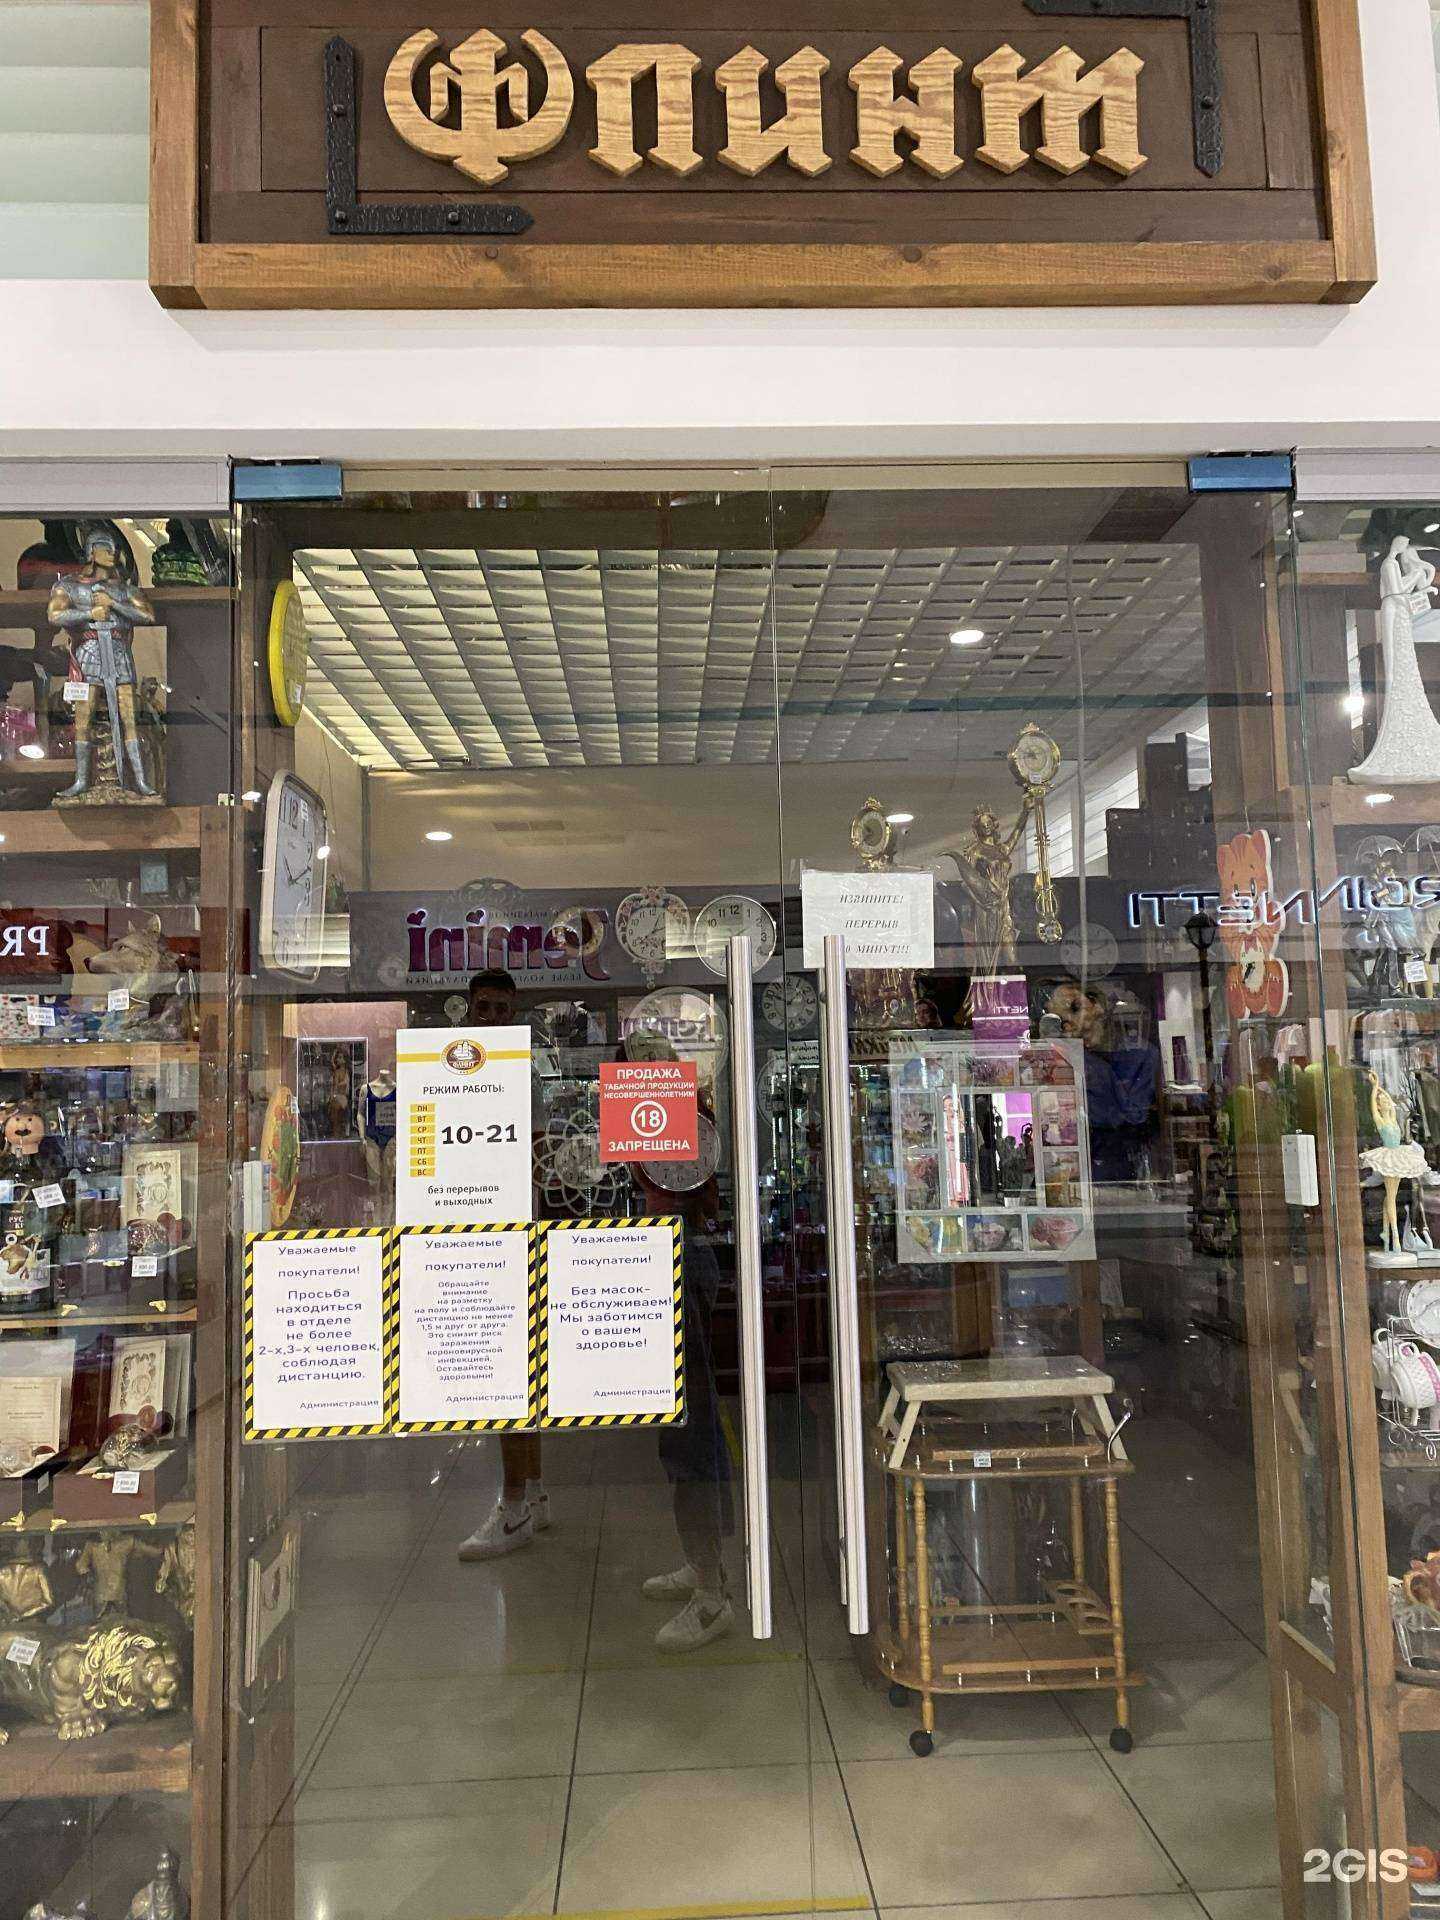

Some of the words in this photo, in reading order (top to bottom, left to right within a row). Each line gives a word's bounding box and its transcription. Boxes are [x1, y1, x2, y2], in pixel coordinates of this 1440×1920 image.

[840, 894, 904, 904] ИЗВИНИТЕ!
[728, 904, 740, 915] 12
[845, 920, 899, 929] ПЕРЕРЫВ
[856, 944, 910, 954] МИНУТ!!!
[616, 1068, 682, 1080] ПРОДАЖА
[423, 1086, 460, 1095] РЕЖИМ
[462, 1084, 505, 1094] РАБОТЫ:
[604, 1082, 646, 1090] ТАБАЧНОЙ
[647, 1082, 694, 1090] ПРОДУКЦИИ
[604, 1090, 694, 1098] НЕСОВЕРШЕННОЛЕТНИМ
[638, 1110, 660, 1128] 18
[441, 1124, 518, 1145] 10-21
[608, 1140, 690, 1152] ЗАПРЕЩЕНА
[428, 1186, 444, 1194] без
[446, 1185, 500, 1195] перерывов
[443, 1198, 493, 1207] выходных
[572, 1234, 648, 1244] Уважаемые
[425, 1240, 504, 1249] Уважаемые
[278, 1245, 357, 1256] Уважаемые
[425, 1260, 506, 1272] покупатели!
[572, 1254, 652, 1268] покупатели!
[278, 1266, 360, 1279] покупатели!
[438, 1280, 490, 1288] Обращайте
[288, 1288, 350, 1300] Просьба
[572, 1286, 597, 1296] Без
[451, 1298, 493, 1306] разметку
[550, 1301, 567, 1310] не
[572, 1296, 673, 1311] обслуживаем!
[276, 1302, 362, 1314] находиться
[460, 1304, 516, 1312] соблюдайте
[287, 1319, 295, 1327] в
[300, 1316, 352, 1327] отделе
[416, 1315, 469, 1323] дистанцию
[560, 1314, 583, 1324] Мы
[587, 1312, 663, 1322] заботимся
[286, 1332, 304, 1340] не
[310, 1329, 352, 1340] более
[582, 1328, 590, 1336] о
[594, 1327, 642, 1336] вашем
[316, 1343, 380, 1353] человек,
[576, 1338, 648, 1352] здоровье!
[282, 1358, 356, 1368] соблюдая
[436, 1364, 494, 1373] Оставайтесь
[277, 1370, 366, 1384] дистанцию.
[440, 1372, 494, 1382] здоровыми!
[446, 1394, 524, 1403] Администрация
[593, 1388, 671, 1399] Администрация
[300, 1400, 379, 1410] Администрация
